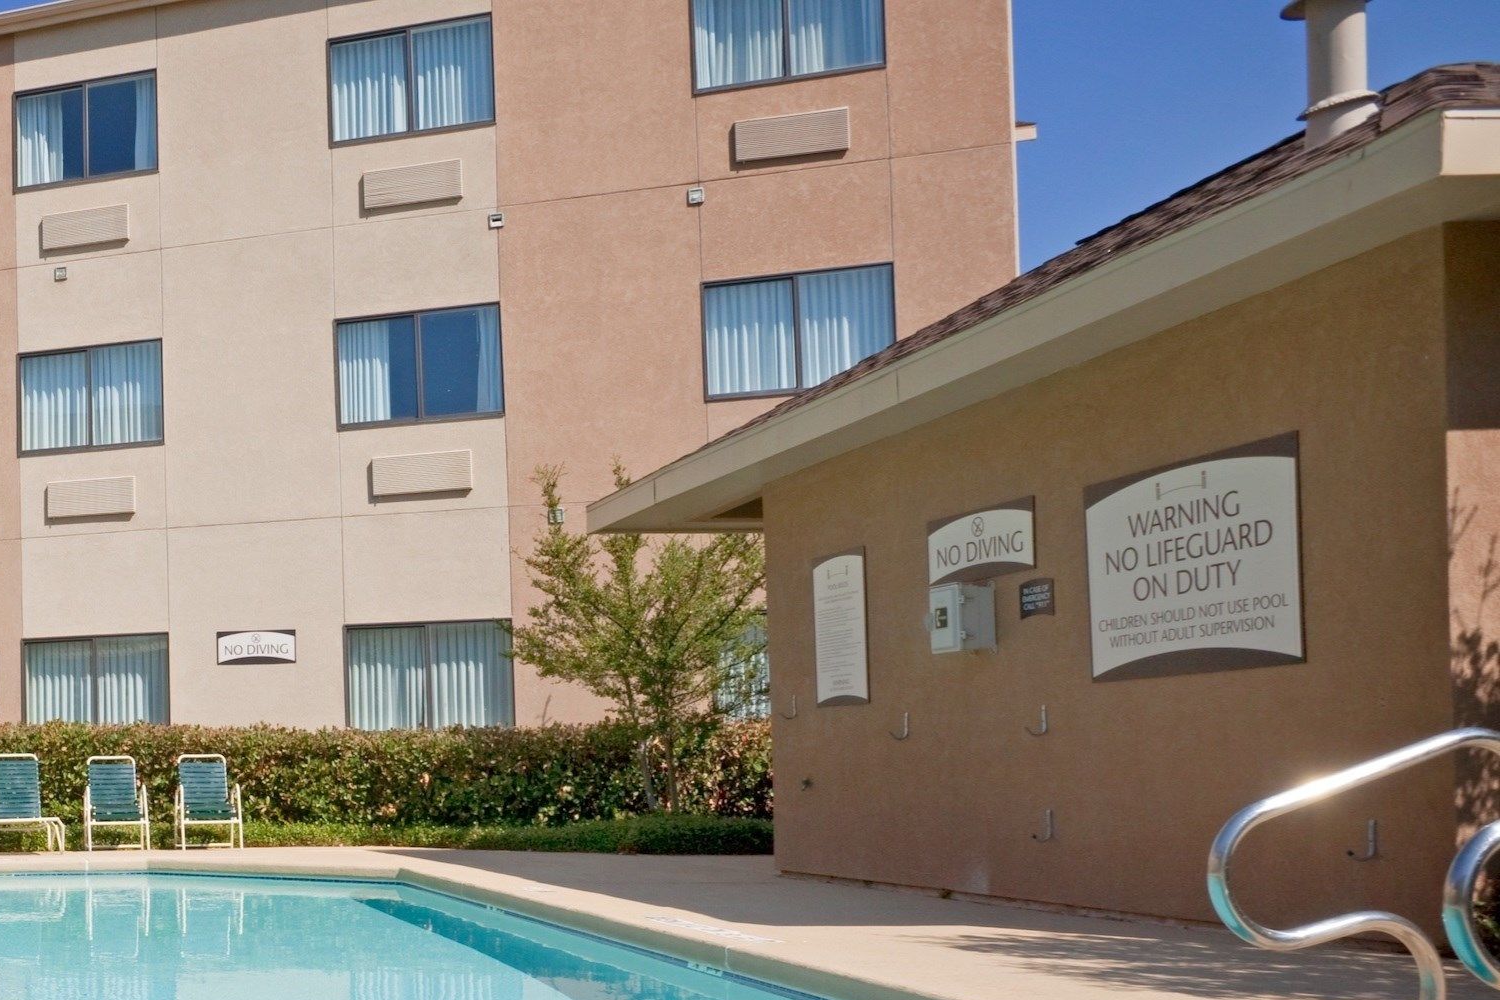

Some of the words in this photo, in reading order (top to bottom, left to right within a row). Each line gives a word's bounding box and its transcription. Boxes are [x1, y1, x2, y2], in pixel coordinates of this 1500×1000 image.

[1128, 490, 1240, 537] WARNING
[936, 545, 961, 569] NO
[966, 530, 1024, 563] DIVING
[1105, 547, 1139, 575] NO
[1147, 519, 1273, 568] LIFEGUARD
[1133, 572, 1168, 601] ON
[1176, 559, 1241, 596] DUTY
[1098, 612, 1148, 632] CHILDREN
[1150, 607, 1196, 625] SHOULD
[1199, 602, 1225, 618] NOT
[1227, 598, 1250, 614] USE
[1252, 593, 1289, 611] POOL
[1109, 630, 1159, 648] WITHOUT
[1160, 625, 1196, 642] ADULT
[1199, 615, 1276, 638] SUPERVISION
[224, 644, 243, 655] NO
[247, 643, 289, 655] DIVING
